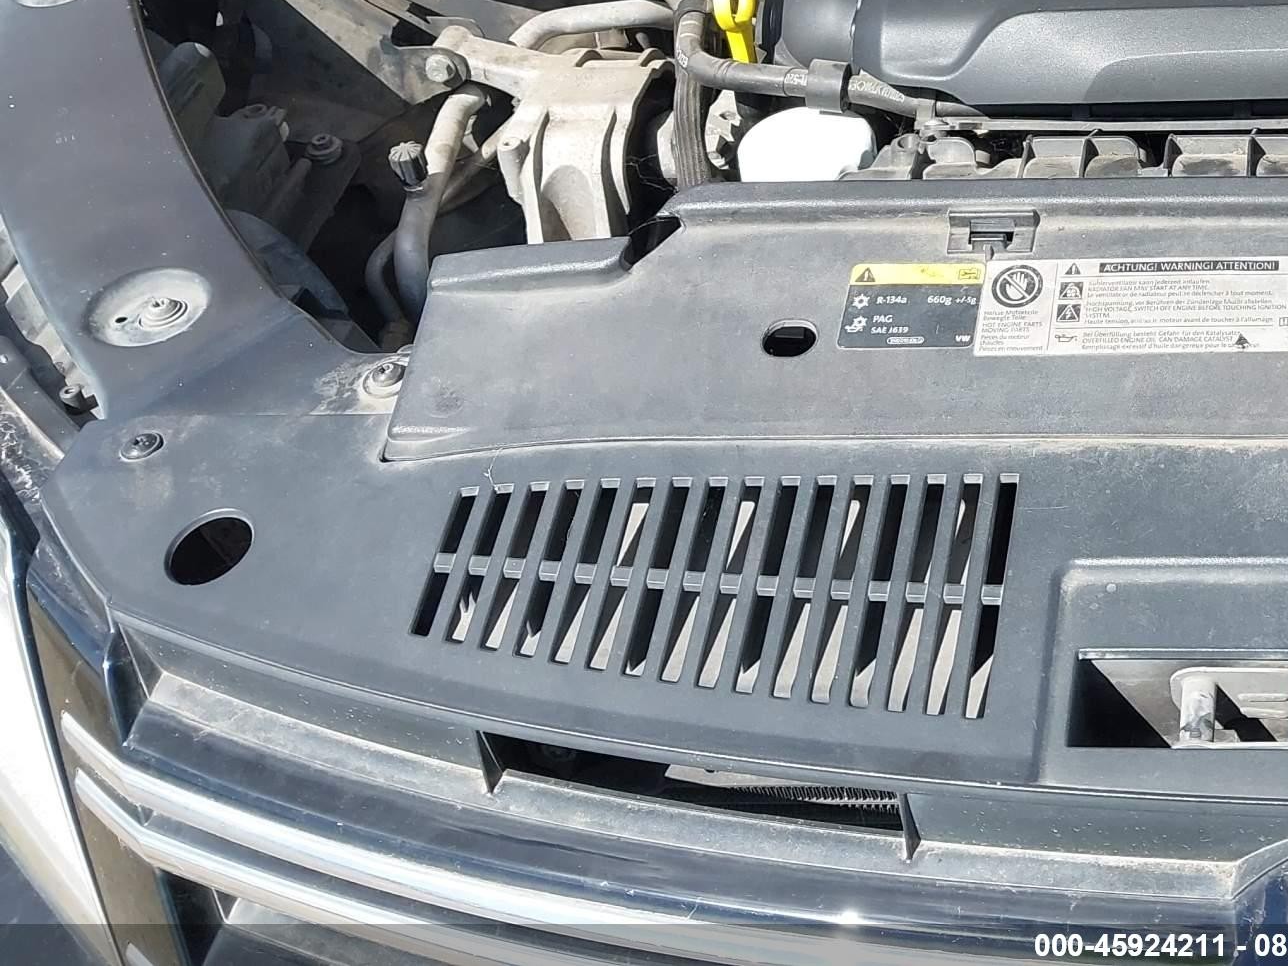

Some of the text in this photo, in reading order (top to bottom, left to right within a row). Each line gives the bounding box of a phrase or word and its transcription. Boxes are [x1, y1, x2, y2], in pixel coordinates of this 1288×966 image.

[1103, 262, 1158, 272] ACHTUNG!
[1216, 261, 1276, 271] ATTENTION!
[876, 295, 907, 305] R-134a
[927, 295, 952, 306] 660g
[872, 315, 893, 323] PAG
[955, 334, 972, 342] VW
